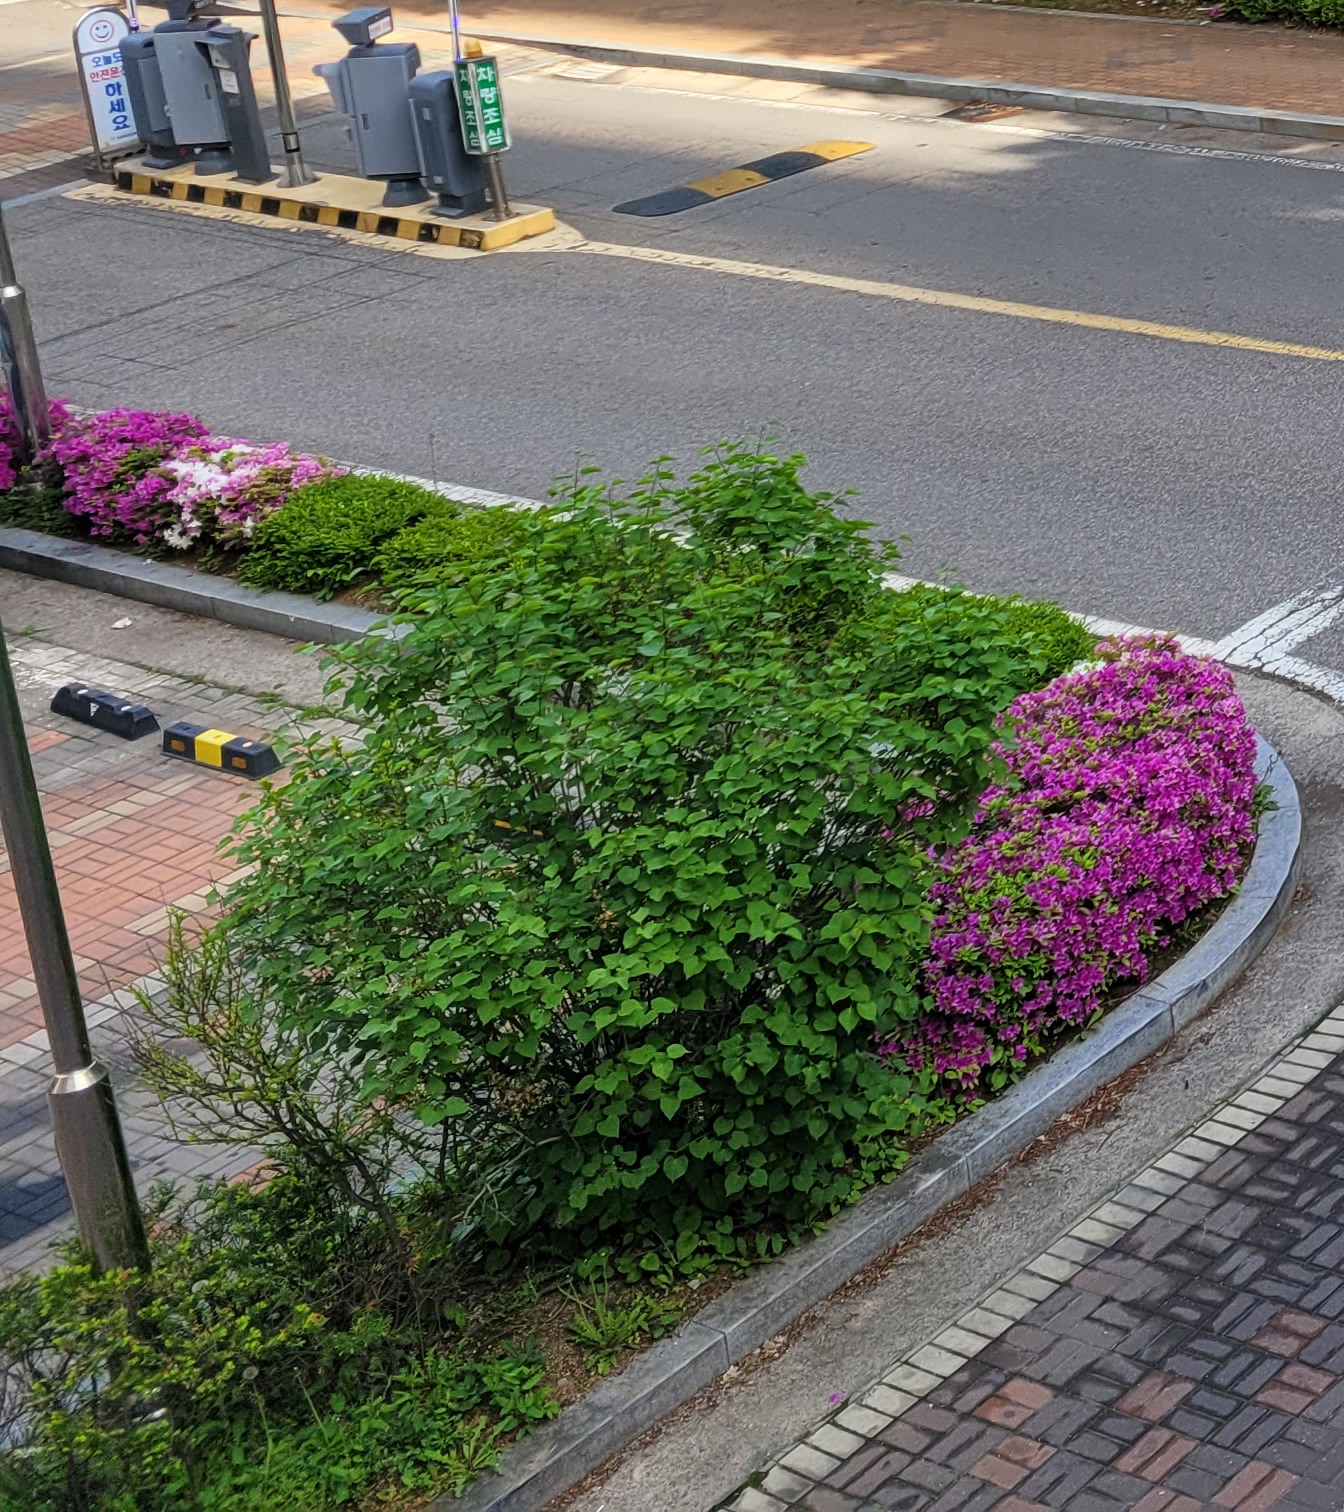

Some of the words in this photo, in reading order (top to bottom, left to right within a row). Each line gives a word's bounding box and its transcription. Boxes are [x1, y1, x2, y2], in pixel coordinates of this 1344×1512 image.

[89, 66, 125, 83] 안전운
[104, 81, 132, 132] 하세요
[477, 66, 503, 146] 차량조심
